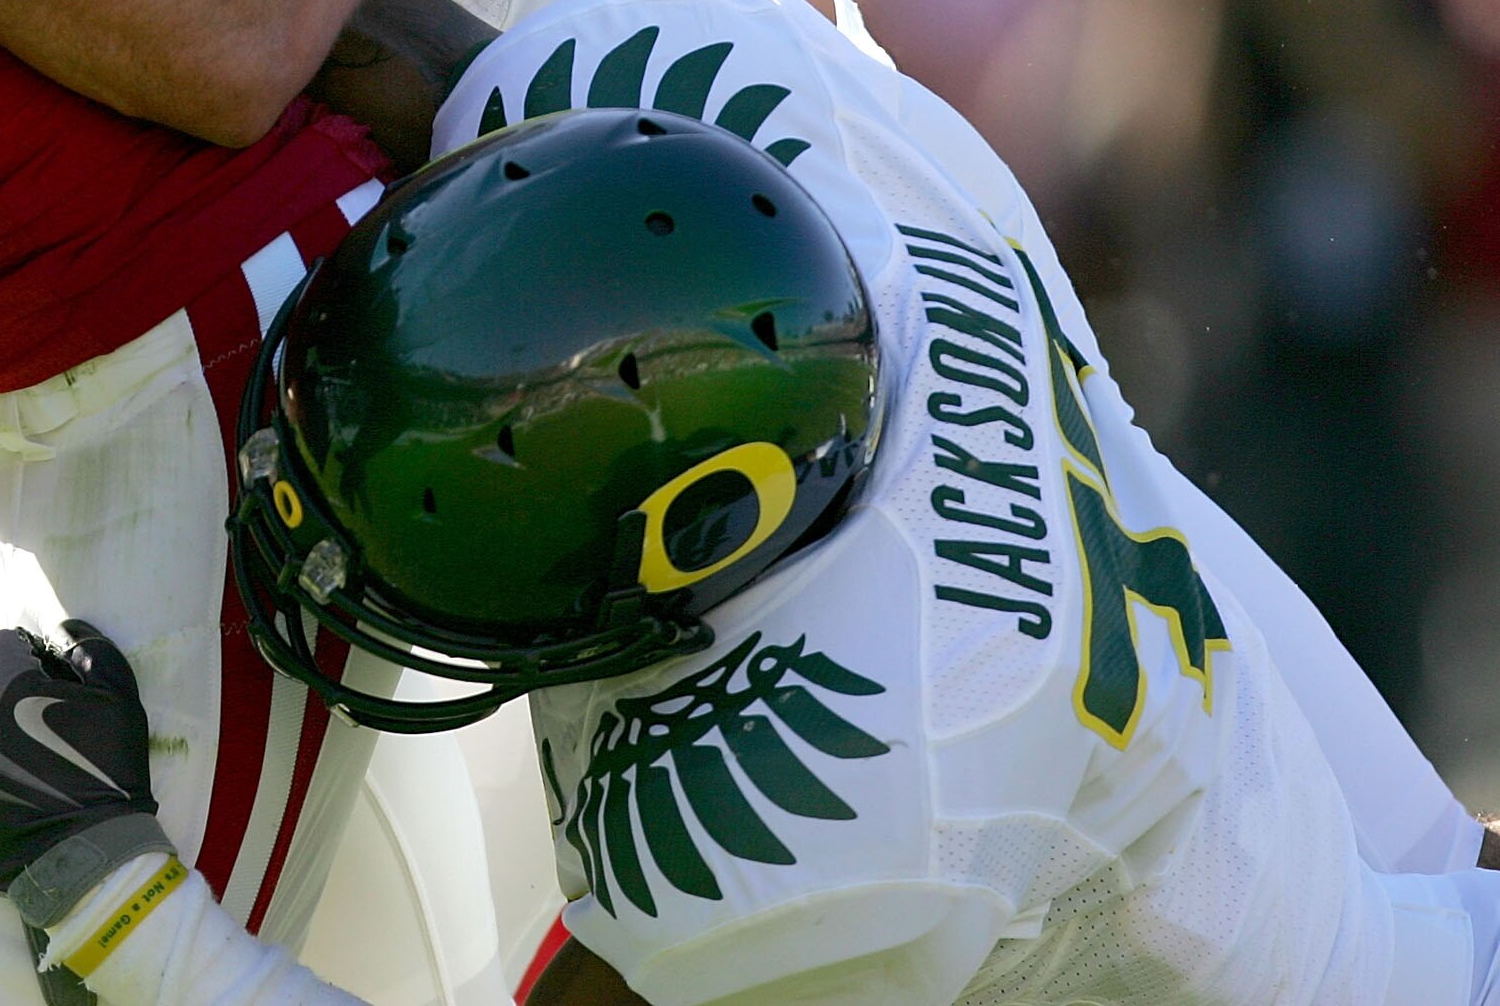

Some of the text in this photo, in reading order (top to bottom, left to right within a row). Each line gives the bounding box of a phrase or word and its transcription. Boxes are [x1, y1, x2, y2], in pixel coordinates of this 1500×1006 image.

[921, 292, 1054, 640] JACKSON
[142, 882, 165, 903] Not
[132, 903, 140, 912] a
[98, 915, 131, 948] Game!
